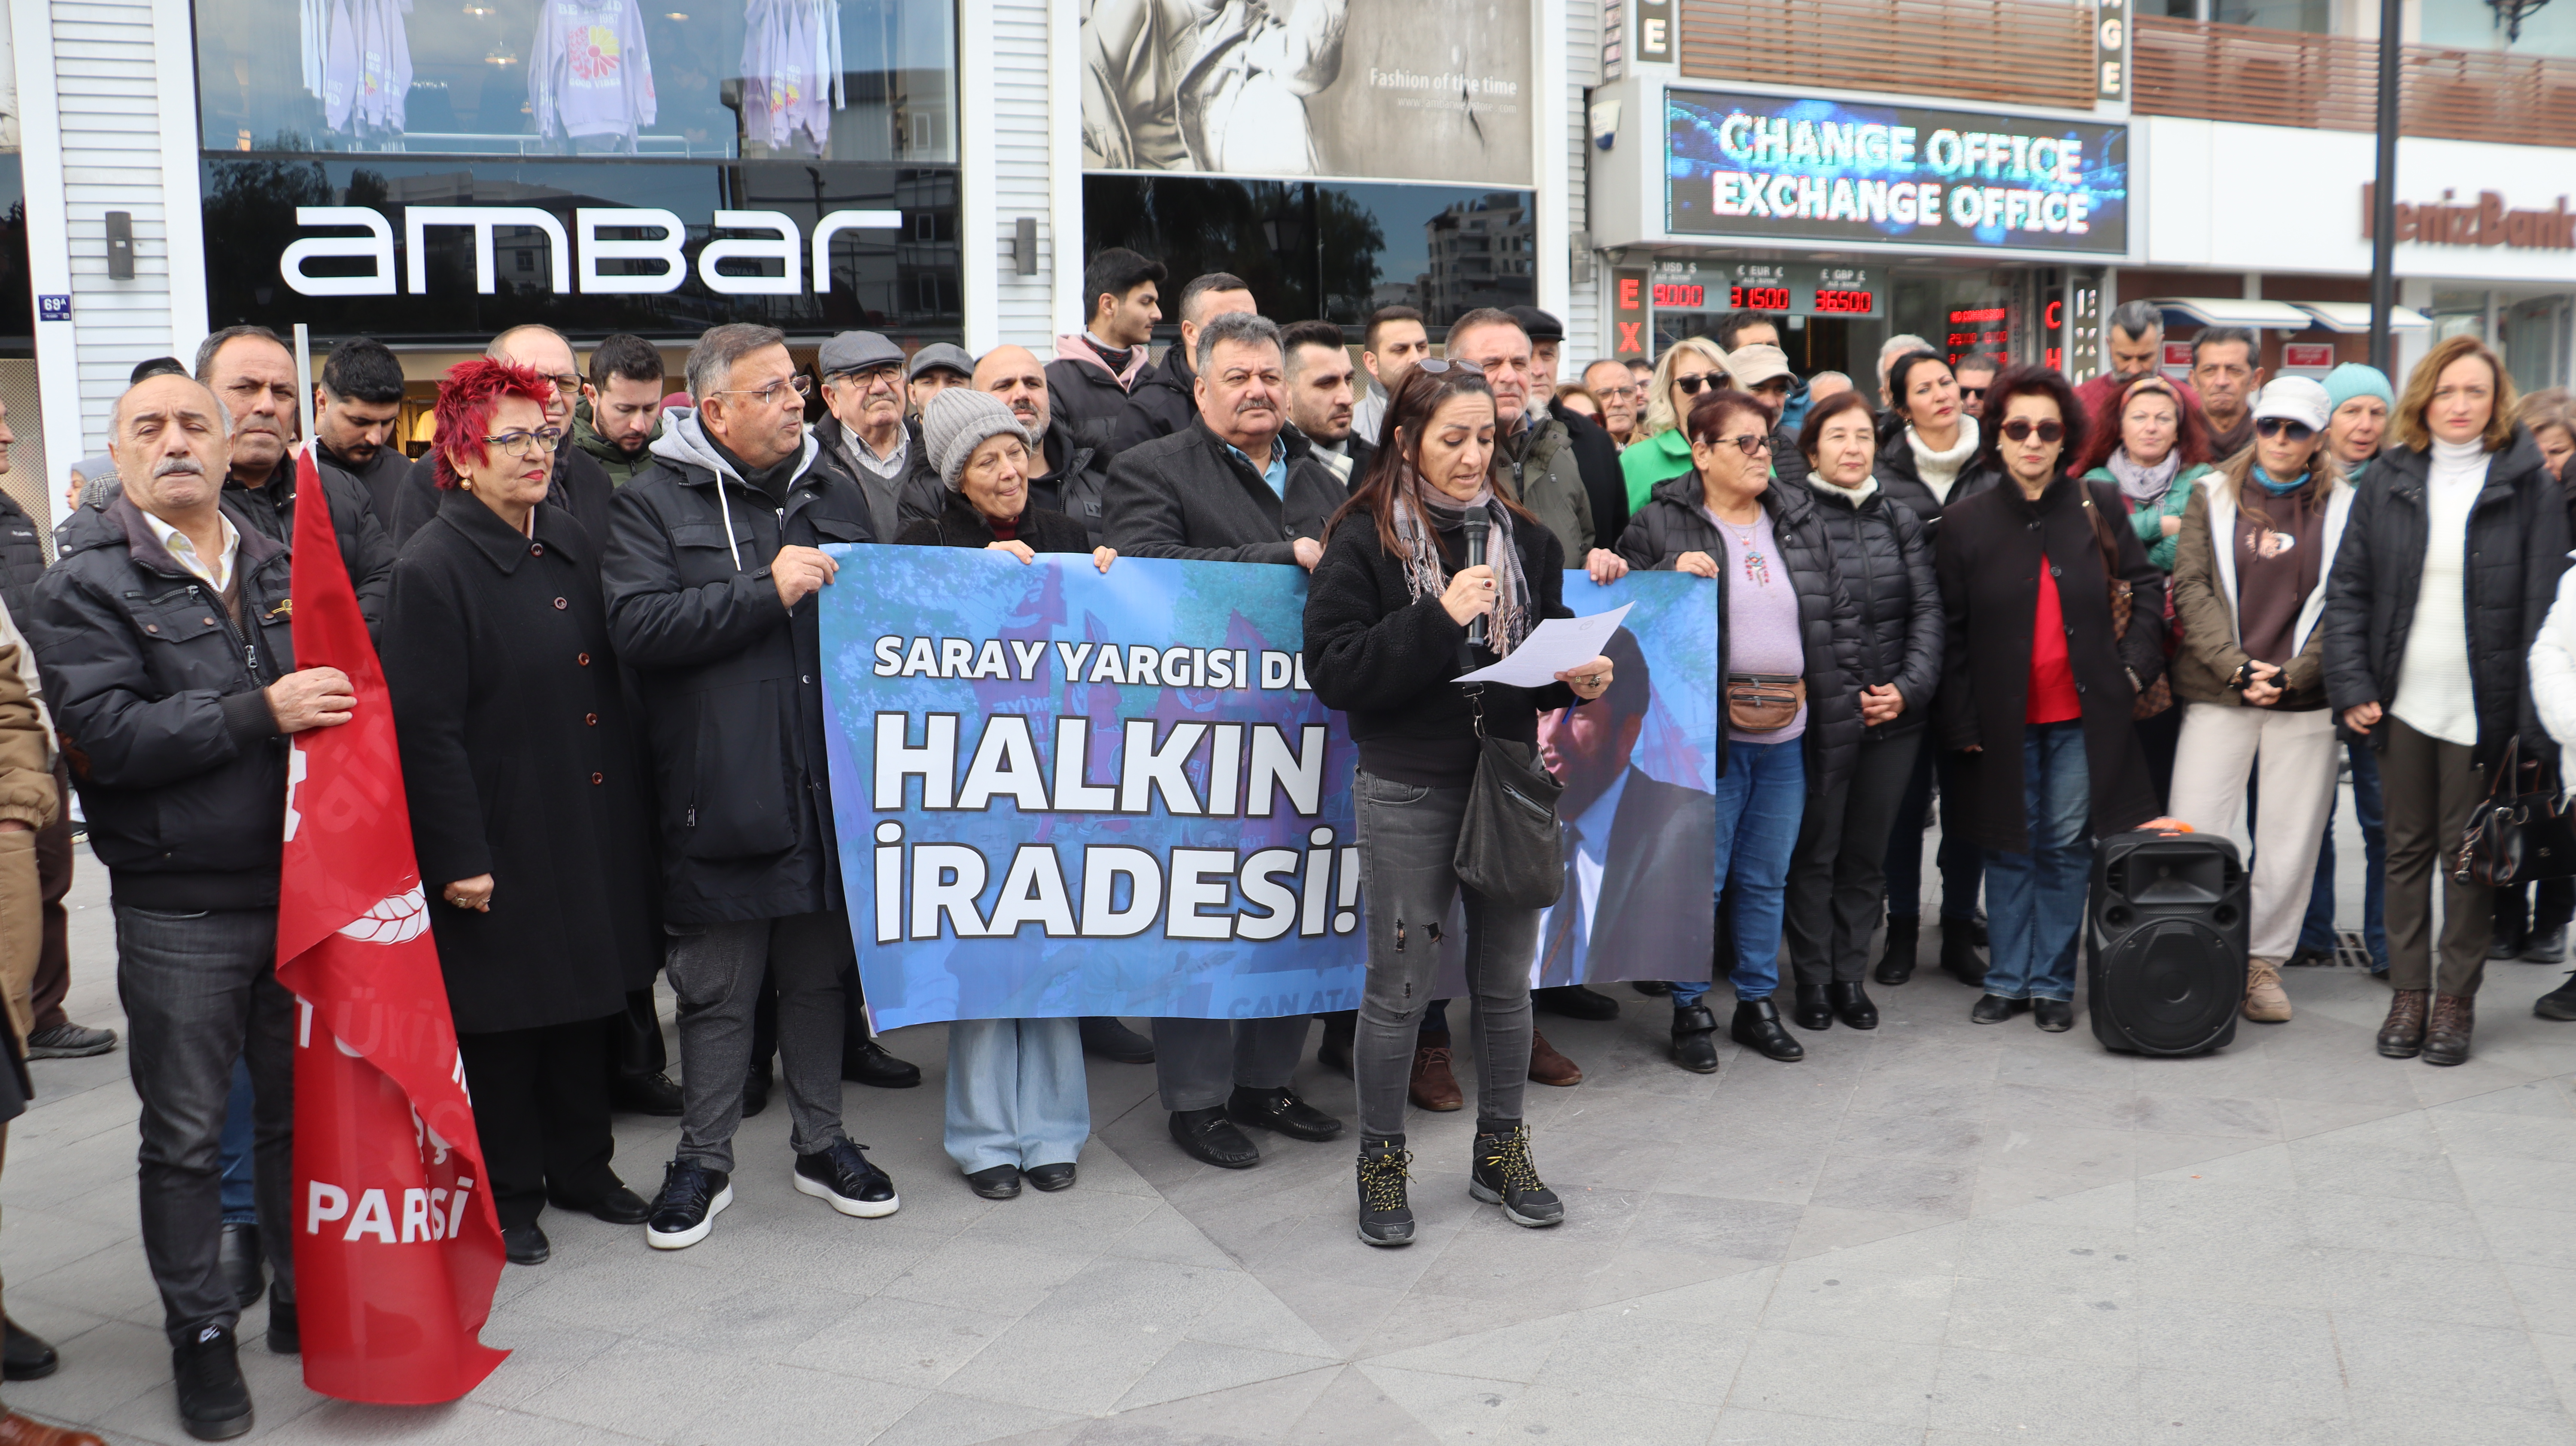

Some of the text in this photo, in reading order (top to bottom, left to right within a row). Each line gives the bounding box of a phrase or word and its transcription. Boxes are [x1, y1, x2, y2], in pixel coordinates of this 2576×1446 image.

[599, 13, 619, 24] 1987
[2099, 0, 2122, 94] GE
[569, 76, 621, 88] GOOD VIBES
[1370, 67, 1517, 94] Fashion of the time
[1719, 113, 2083, 185] CHANGE OFFICE
[1712, 170, 2090, 234] EXCHANGE OFFICE
[1664, 262, 1683, 272] USD
[1751, 265, 1770, 276] EUR
[1835, 269, 1854, 279] GBP
[872, 635, 1048, 680] SARAY
[1055, 641, 1249, 690] YARGISI
[872, 711, 1329, 818] HALKIN
[873, 819, 1360, 945] İRADESİ!
[1227, 992, 1300, 1019] CAN
